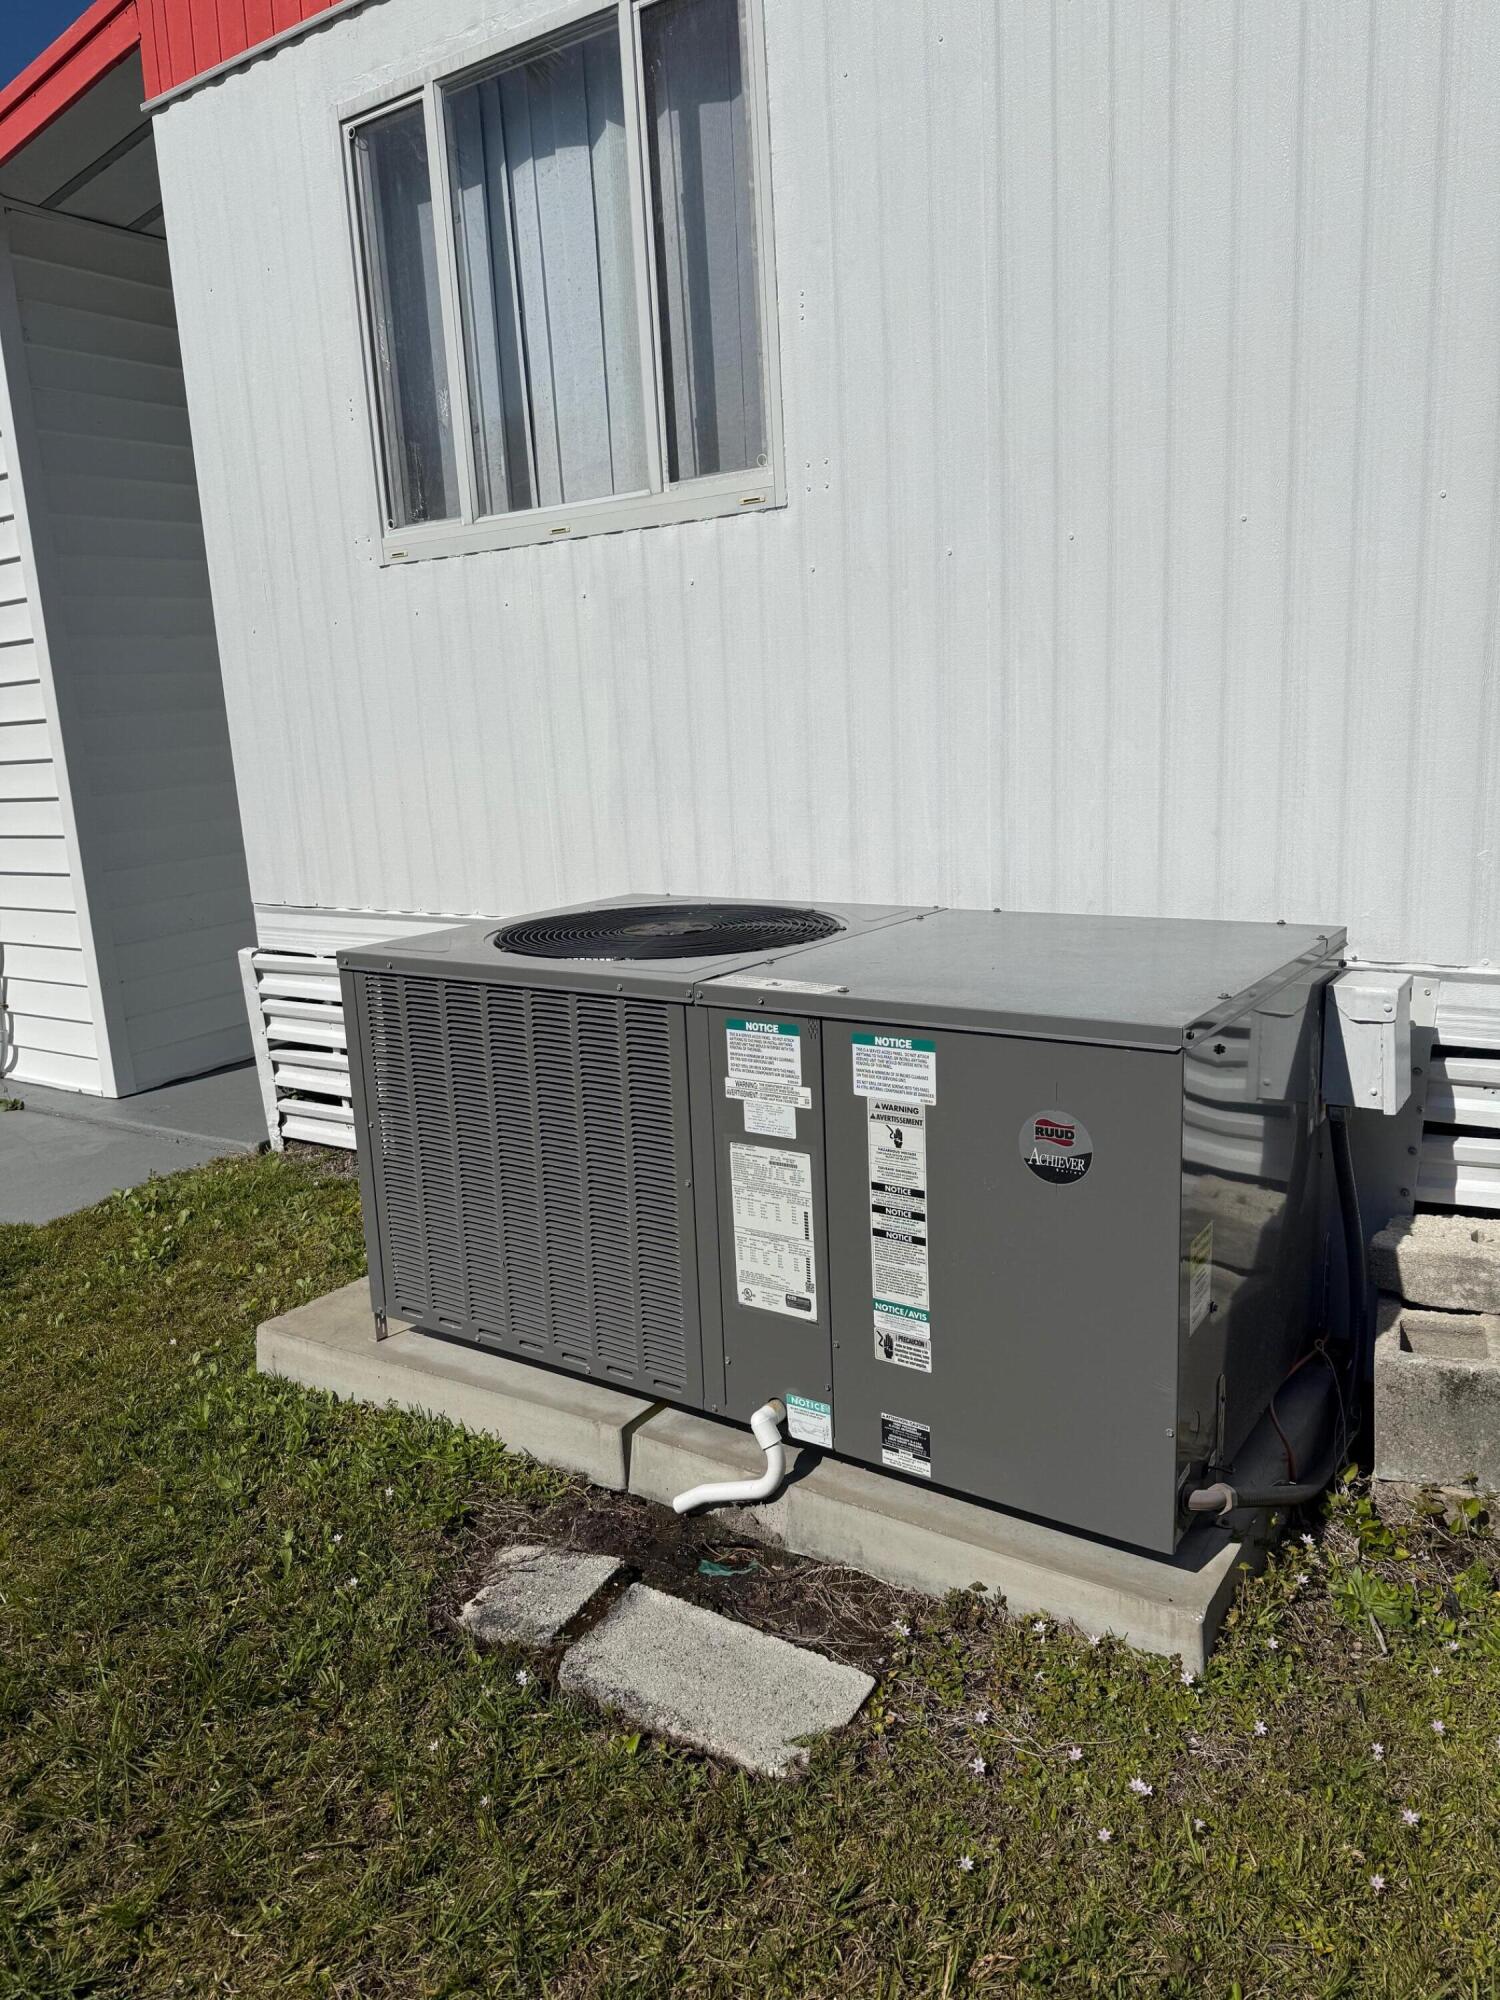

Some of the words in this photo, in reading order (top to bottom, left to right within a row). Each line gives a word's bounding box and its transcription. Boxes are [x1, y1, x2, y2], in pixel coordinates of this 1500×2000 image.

[745, 1021, 779, 1033] NOTICE
[874, 1036, 912, 1048] NOTICE
[881, 1103, 919, 1115] WARNING
[876, 1113, 923, 1126] AVERTISSEMENT
[1035, 1126, 1075, 1140] RUUD
[1028, 1147, 1085, 1171] ACHIEVER
[884, 1185, 912, 1196] NOTICE
[885, 1207, 912, 1219] NOTICE
[886, 1231, 913, 1243] NOTICE
[791, 1396, 826, 1412] NOTICE
